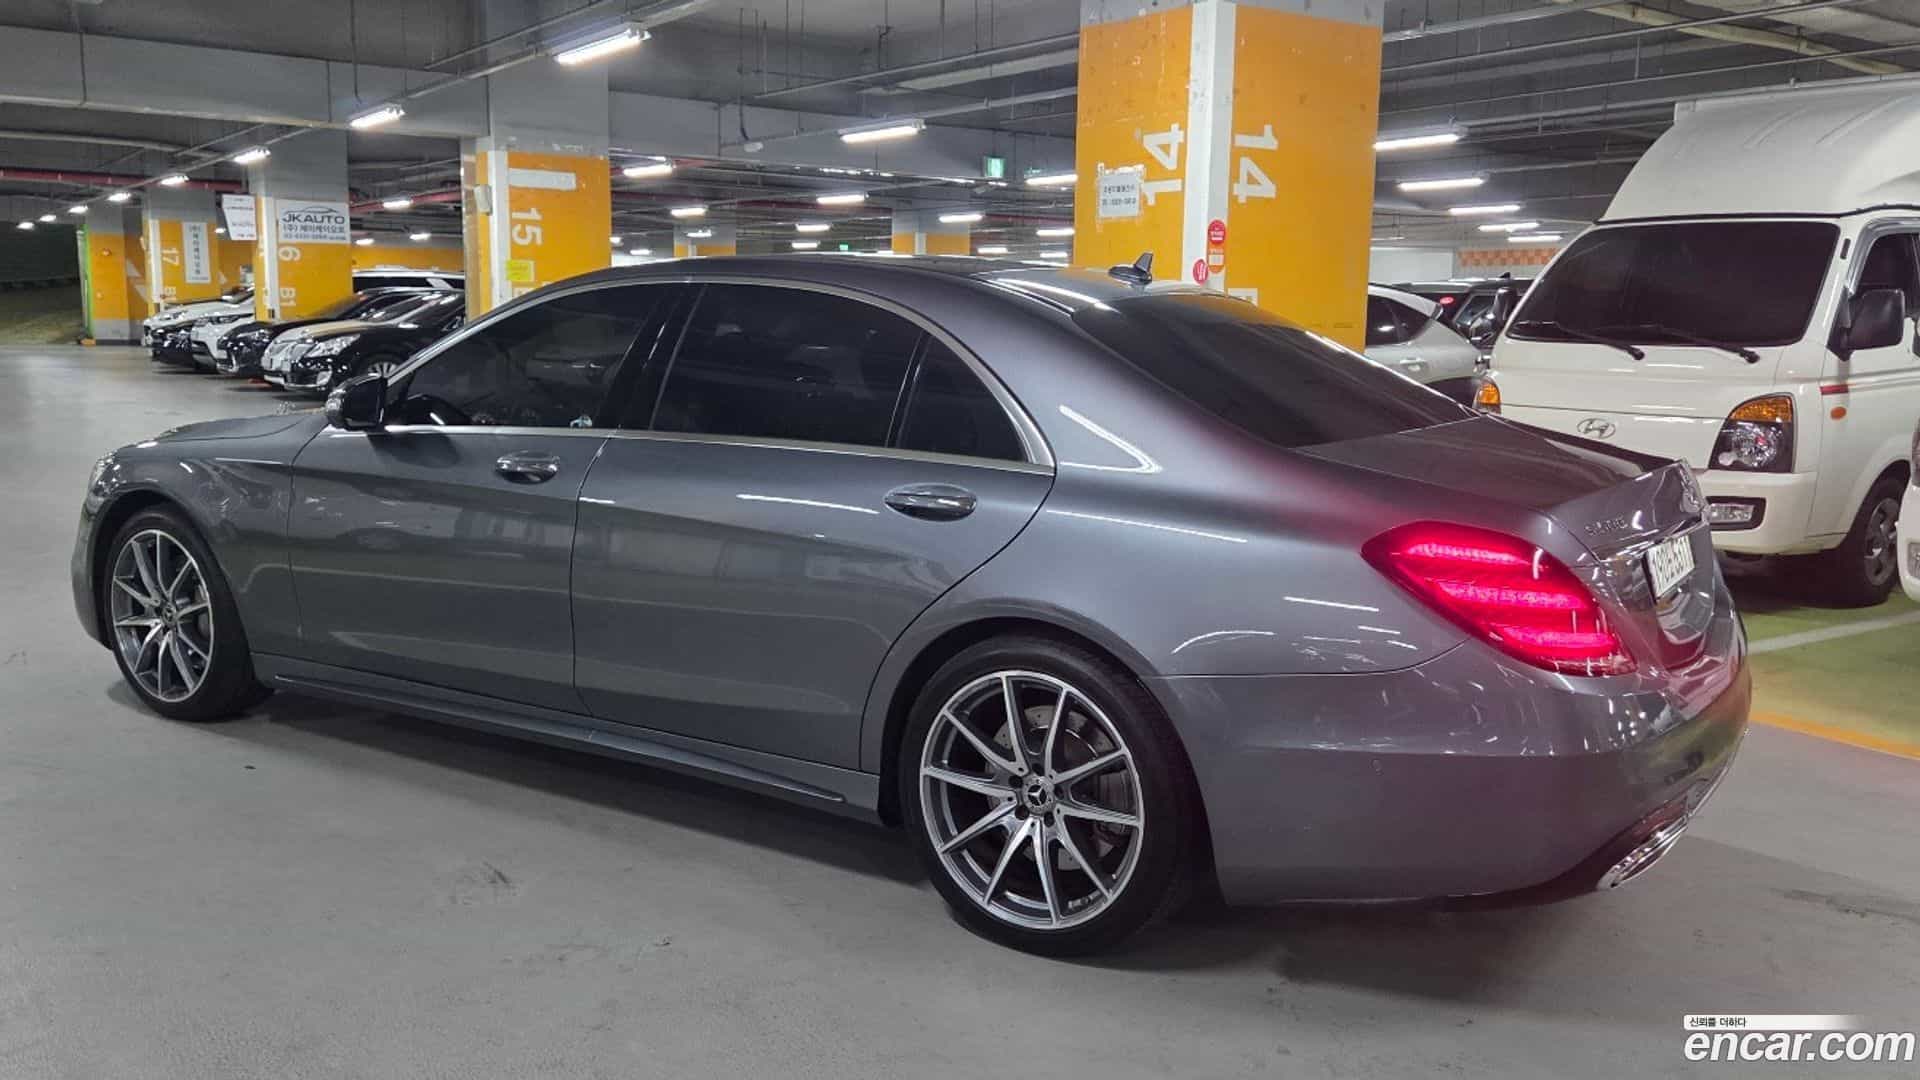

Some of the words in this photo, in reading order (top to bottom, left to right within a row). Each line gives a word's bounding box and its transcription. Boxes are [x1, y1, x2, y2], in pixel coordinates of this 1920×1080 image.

[1143, 123, 1184, 206] 14
[1233, 124, 1279, 204] 14
[511, 207, 543, 246] 15
[163, 247, 180, 266] 17
[280, 287, 297, 307] B1
